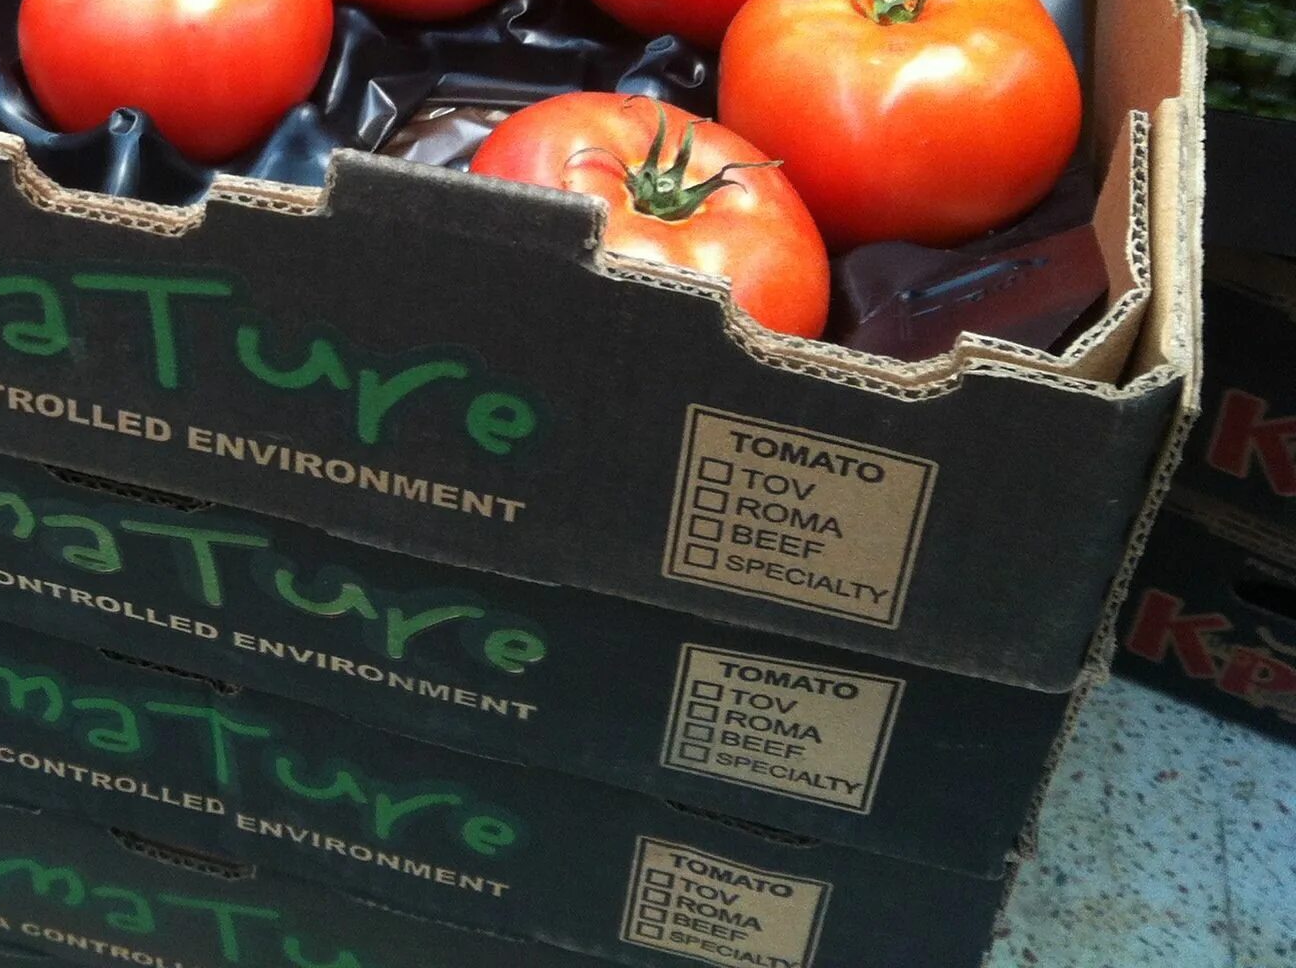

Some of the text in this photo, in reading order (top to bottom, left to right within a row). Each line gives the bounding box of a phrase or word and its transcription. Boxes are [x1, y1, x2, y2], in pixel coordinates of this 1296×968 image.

[187, 425, 527, 523] ENVIRONMENT
[730, 431, 885, 484] TOMATO
[741, 469, 816, 500] TOV
[736, 497, 843, 538] ROMA
[731, 524, 825, 559] BEEF
[725, 555, 889, 604] SPECIALTY
[232, 632, 539, 720] ENVIRONMENT
[719, 661, 859, 700] TOMATO
[729, 688, 798, 714] TOV
[720, 731, 806, 759] BEEF
[725, 710, 822, 744] ROMA
[715, 751, 864, 795] SPECIALTY
[236, 813, 510, 899] ENVIRONMENT
[670, 853, 794, 898] TOMATO
[681, 877, 740, 906] TOV
[672, 912, 749, 941] BEEF
[676, 895, 763, 932] ROMA
[670, 931, 801, 968] SPECIALTY
